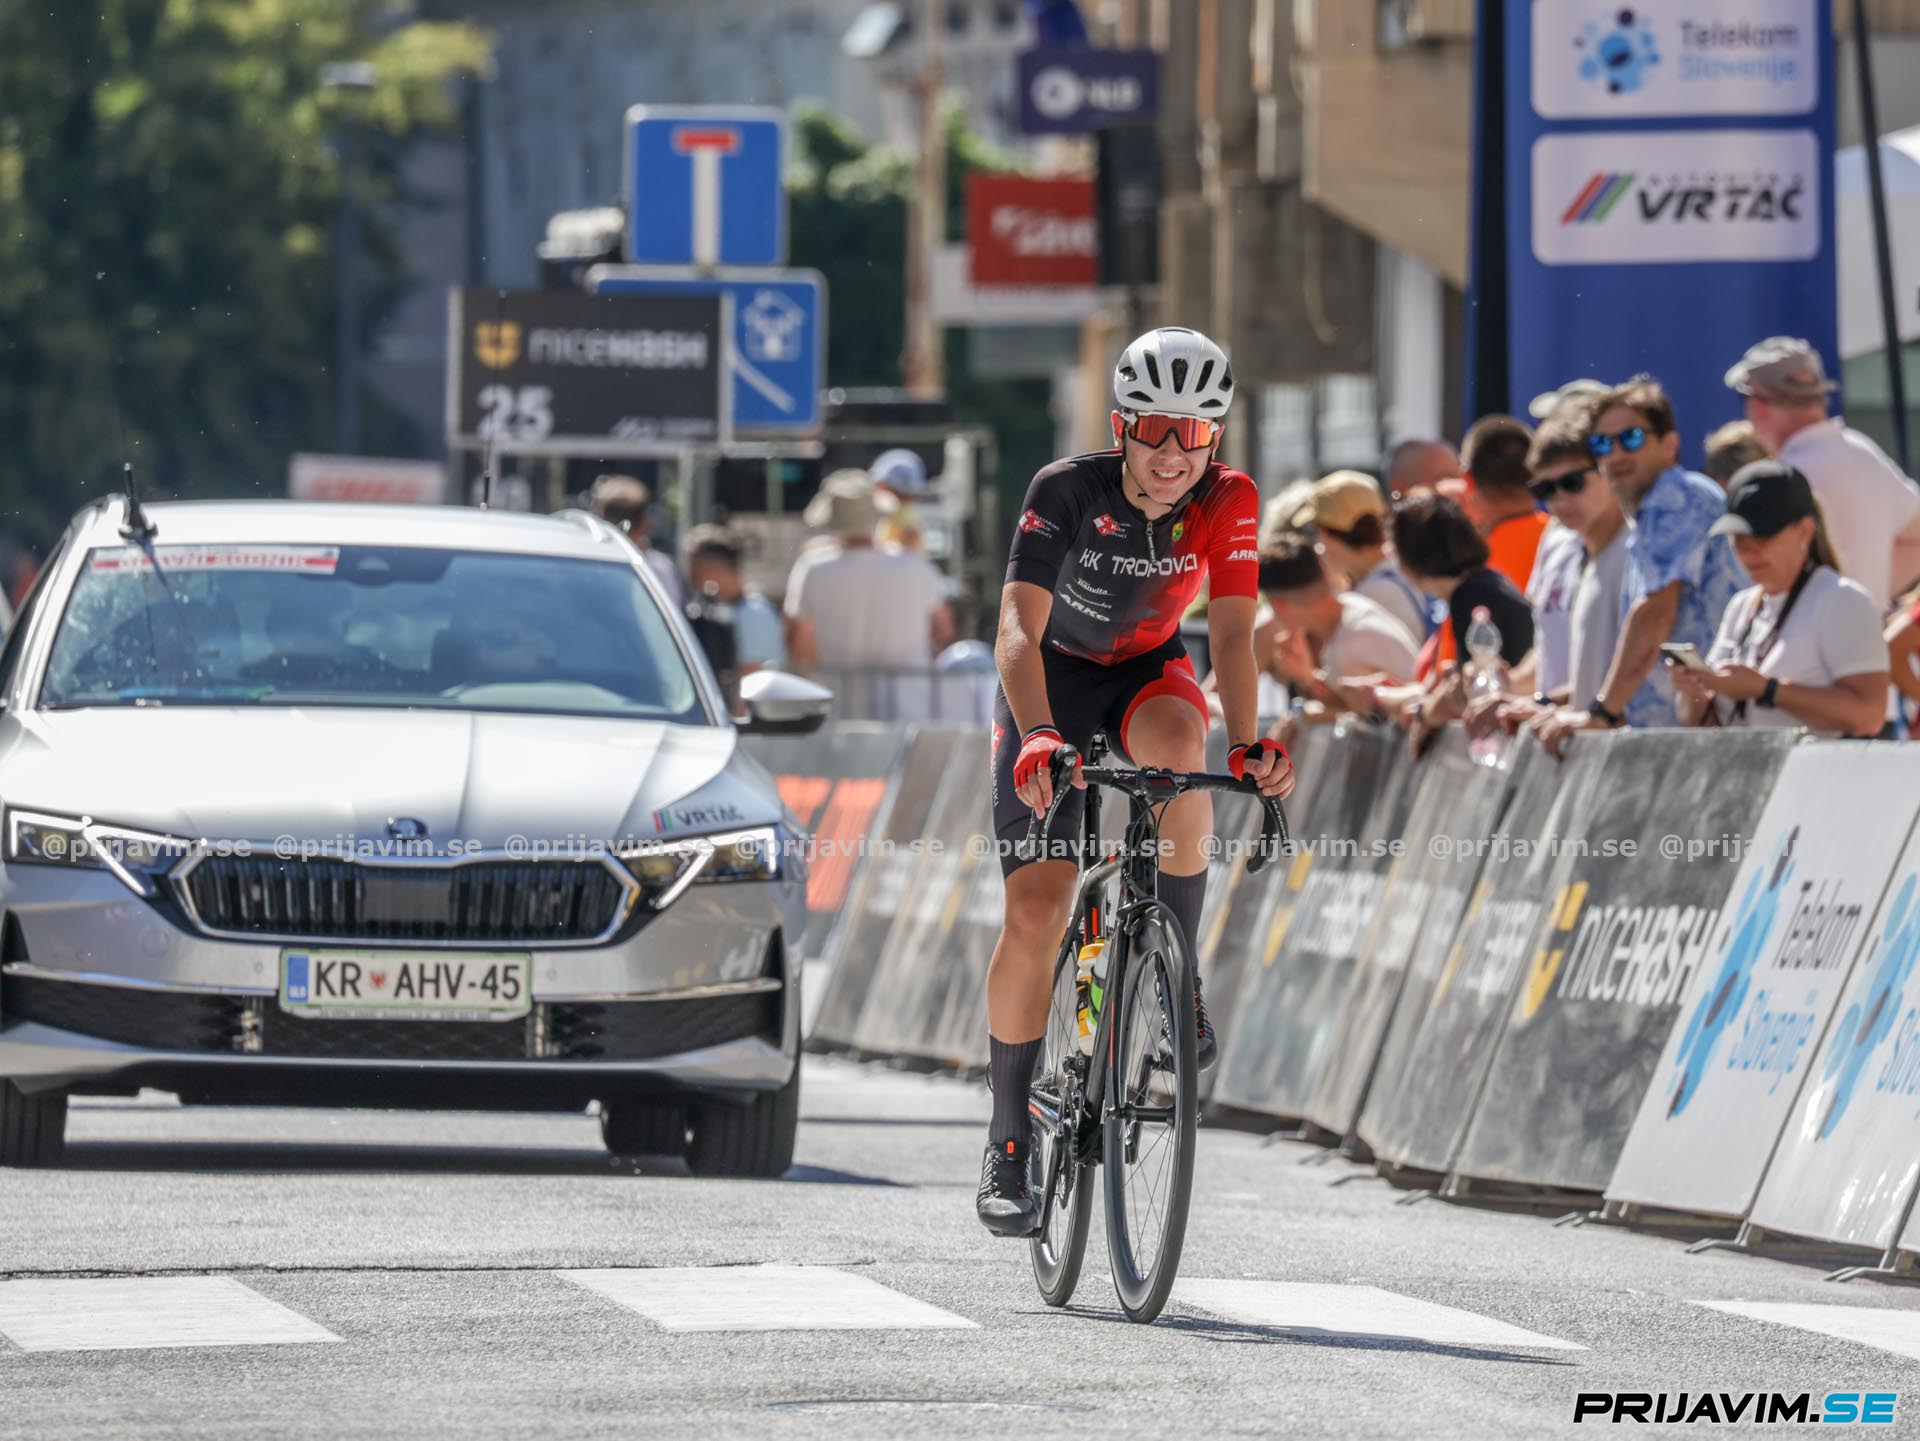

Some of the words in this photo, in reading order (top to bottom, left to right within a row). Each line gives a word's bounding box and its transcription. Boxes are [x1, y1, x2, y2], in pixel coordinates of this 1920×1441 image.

[1679, 20, 1799, 48] Telekom
[1678, 53, 1798, 87] Slovenije
[1637, 185, 1804, 224] VRTAC
[478, 384, 553, 441] 25
[1079, 548, 1103, 571] KK
[316, 961, 362, 998] KR
[394, 962, 521, 999] AHV-45
